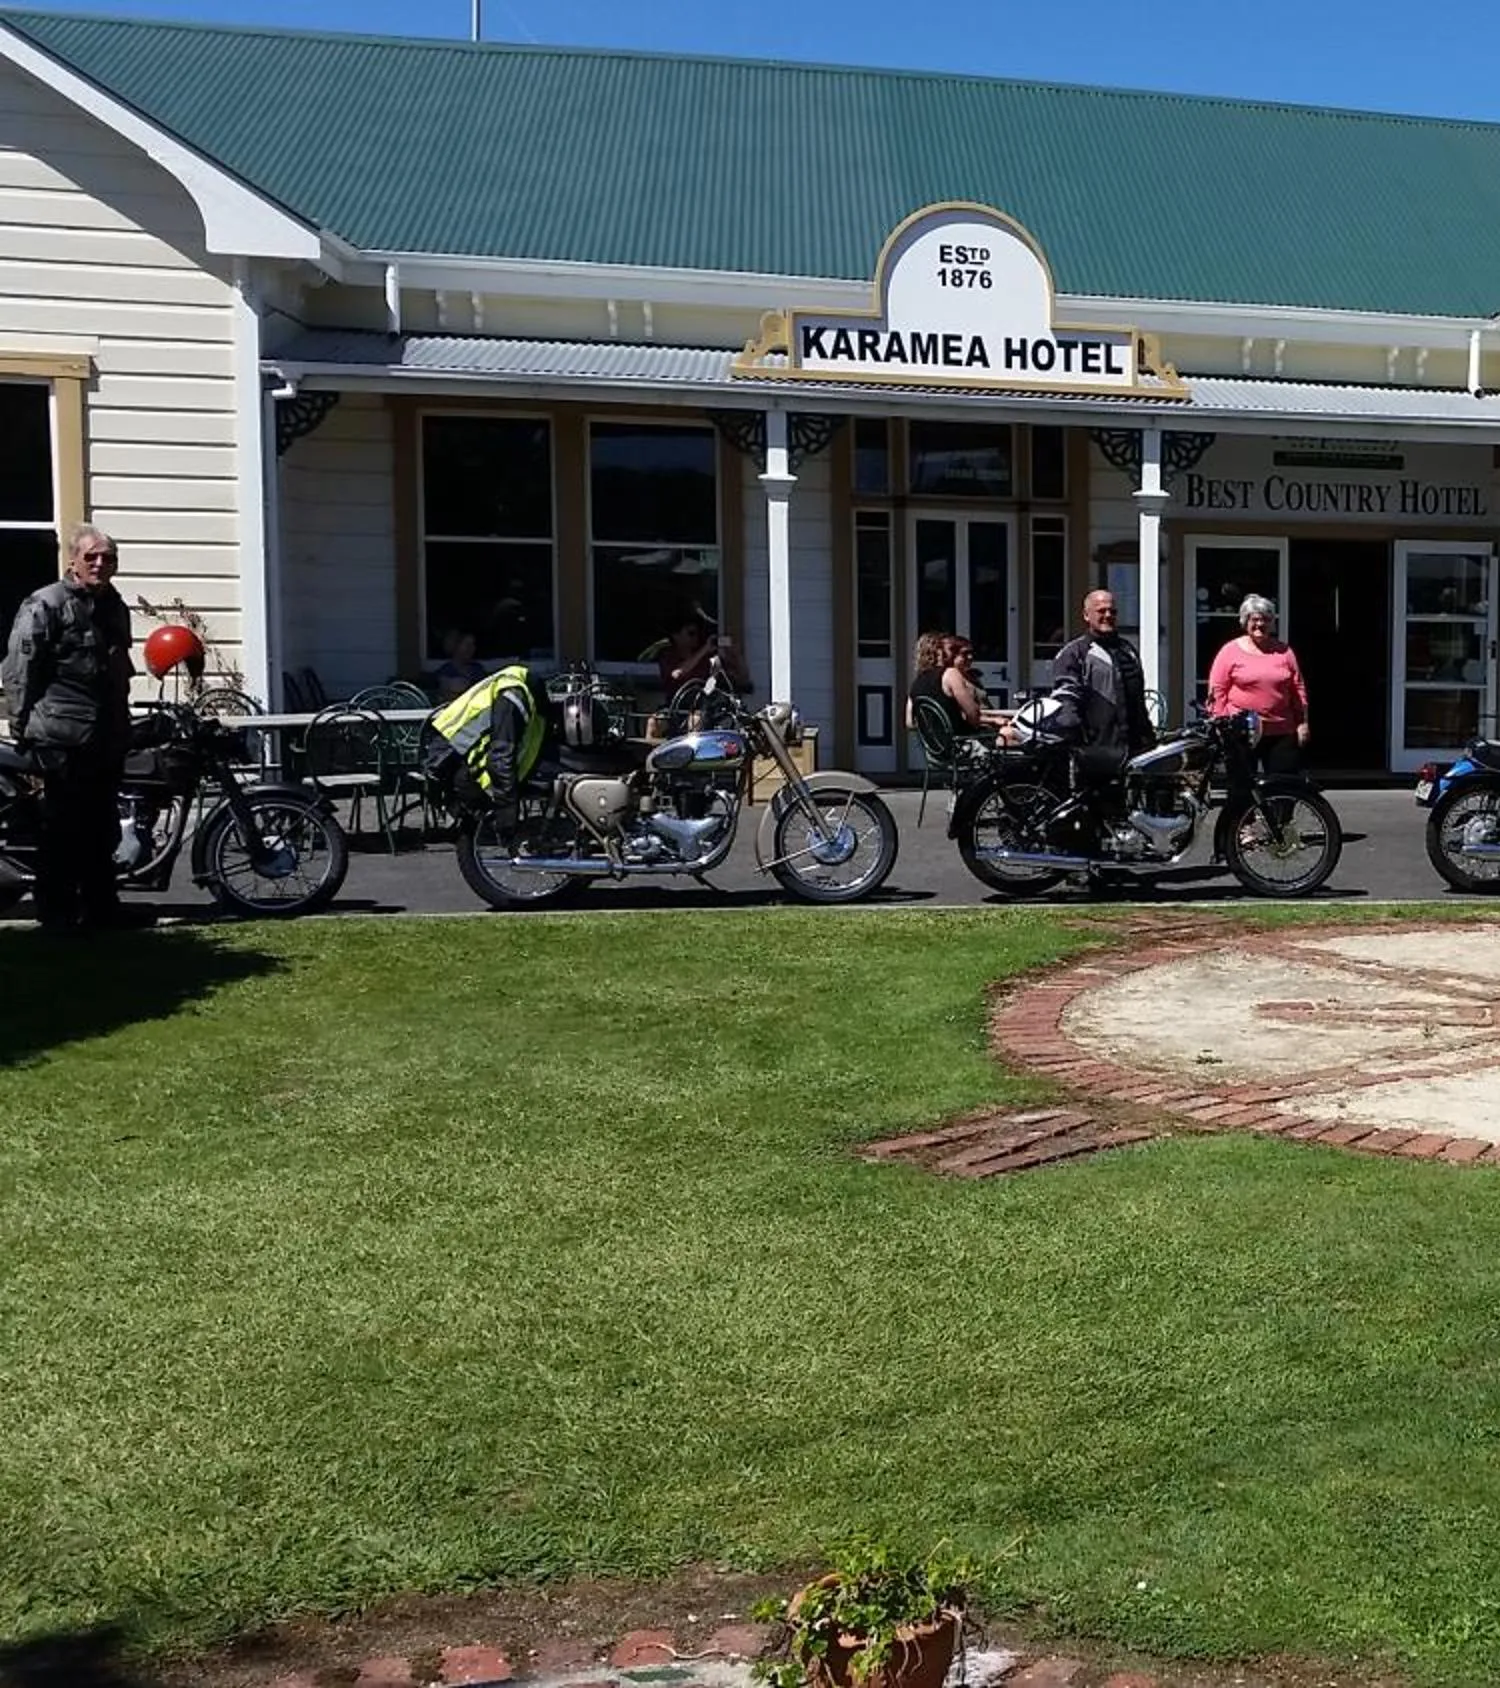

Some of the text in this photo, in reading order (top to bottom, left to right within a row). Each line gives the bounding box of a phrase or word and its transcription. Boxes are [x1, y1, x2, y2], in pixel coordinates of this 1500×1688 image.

[936, 268, 993, 290] 1876
[802, 325, 1124, 376] KARAMEA HOTEL
[1185, 472, 1488, 516] BEST COUNTRY HOTEL
